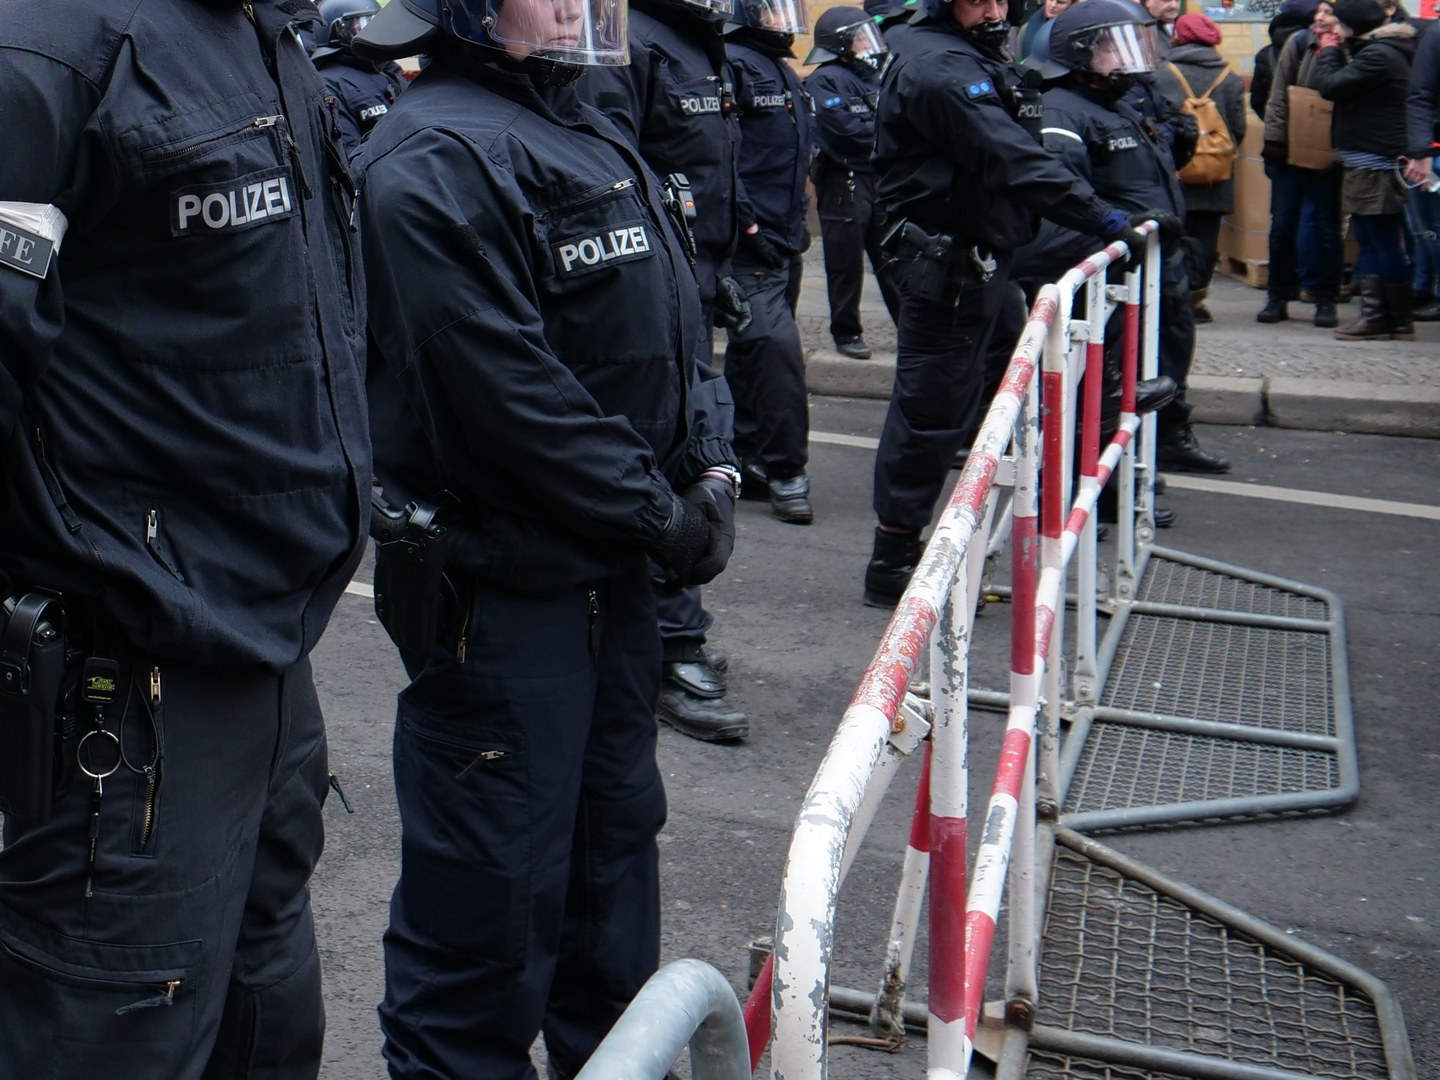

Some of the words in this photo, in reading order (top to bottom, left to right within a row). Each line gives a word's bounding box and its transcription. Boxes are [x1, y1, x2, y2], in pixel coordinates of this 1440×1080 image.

[680, 96, 720, 113] POLIZEI
[178, 177, 292, 230] POLIZEI
[559, 226, 650, 272] POLIZEI
